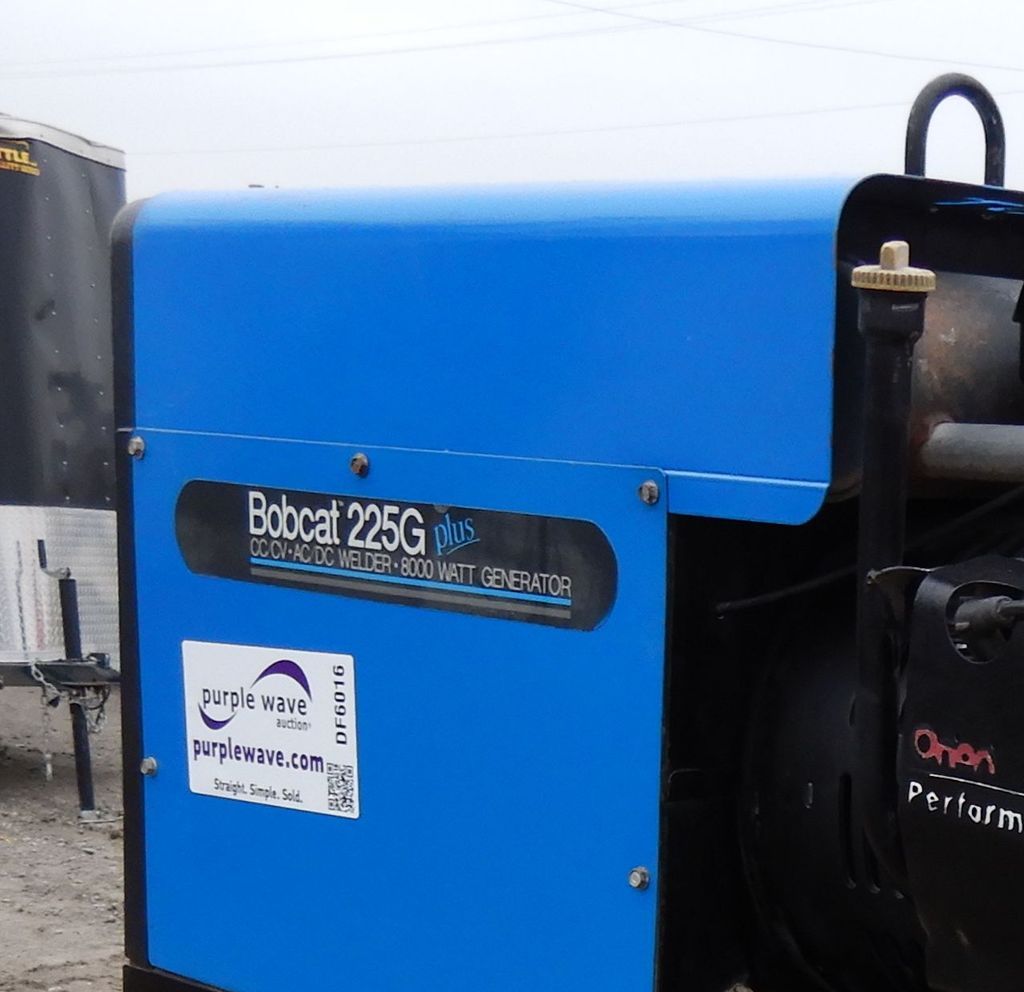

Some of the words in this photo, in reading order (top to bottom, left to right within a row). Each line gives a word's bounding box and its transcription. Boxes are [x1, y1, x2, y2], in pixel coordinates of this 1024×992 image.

[248, 491, 340, 545] Bobcat
[347, 502, 426, 556] 225G
[434, 513, 476, 556] plus
[339, 549, 392, 574] WELDER
[401, 557, 434, 579] 8000
[437, 561, 476, 585] WATT
[481, 566, 572, 597] GENERATOR
[202, 687, 256, 713] purple
[261, 694, 308, 716] wave
[332, 665, 348, 746] DF6016
[276, 717, 310, 731] auction
[193, 737, 324, 773] purplewave.com
[214, 778, 247, 797] Straight.
[250, 783, 280, 801] Simple.
[282, 788, 304, 804] Sold.
